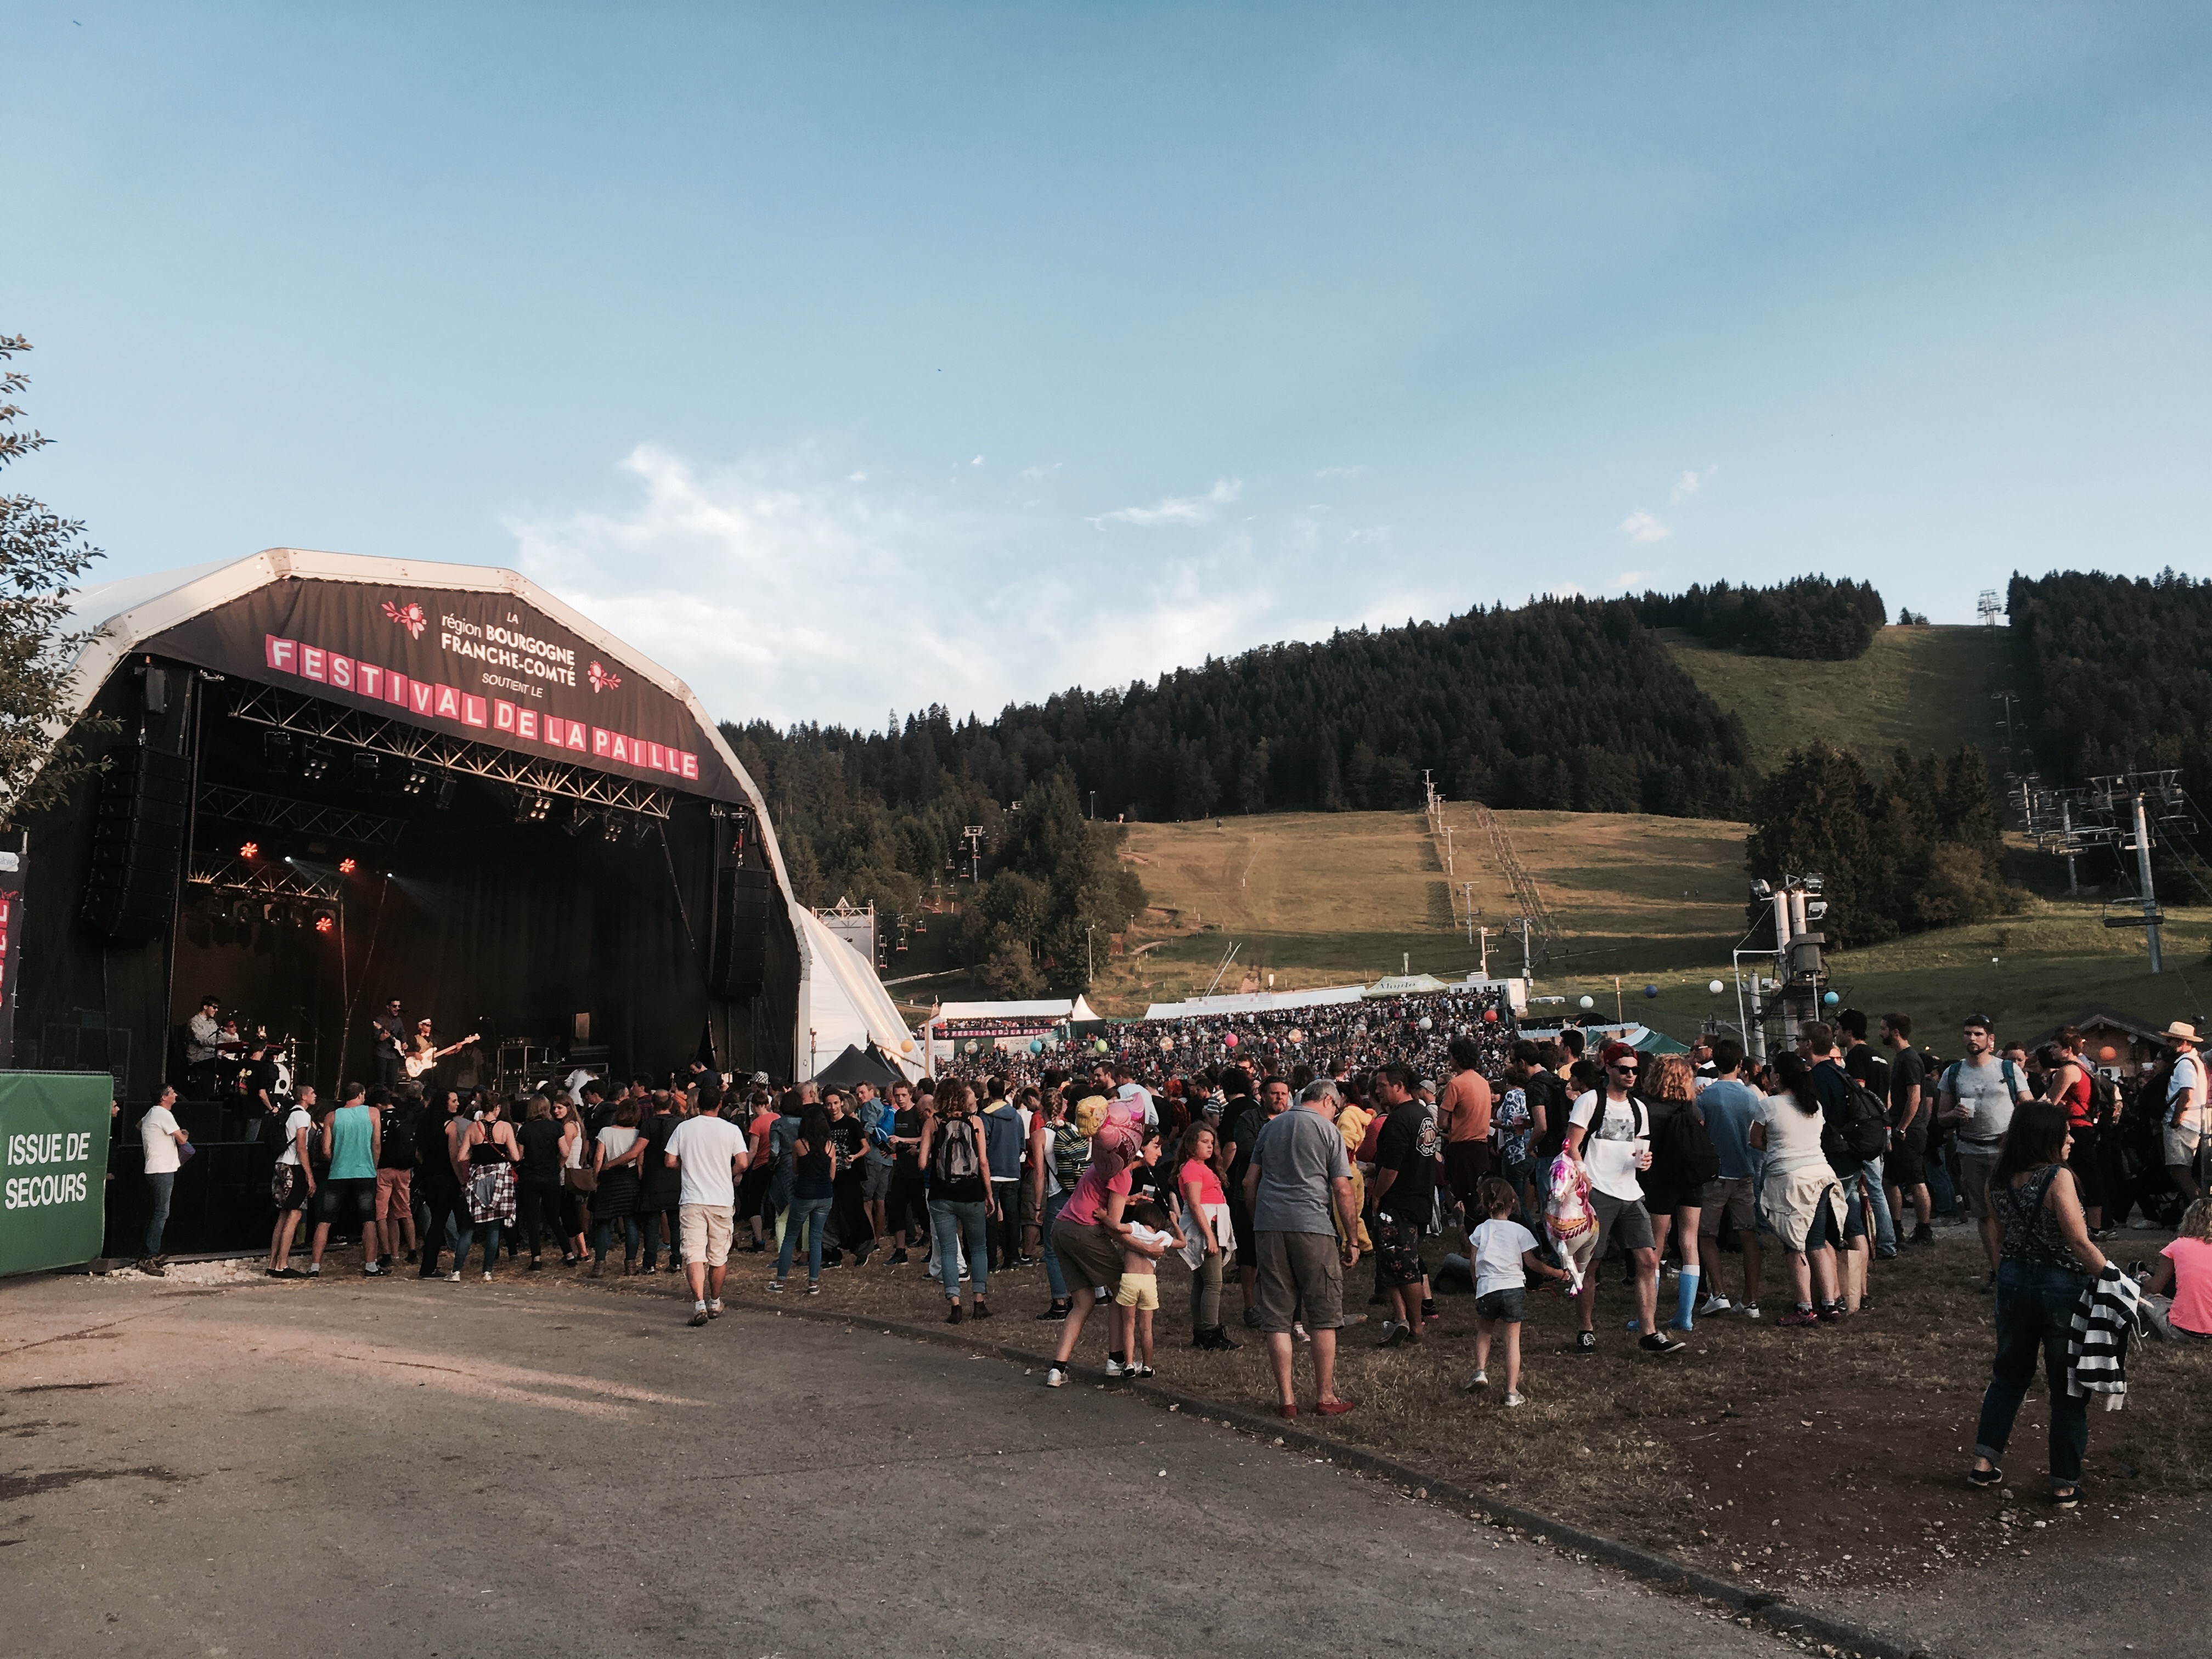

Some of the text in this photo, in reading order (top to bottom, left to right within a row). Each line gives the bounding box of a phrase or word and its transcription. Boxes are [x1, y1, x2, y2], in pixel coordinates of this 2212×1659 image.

[506, 612, 519, 624] LA
[441, 613, 575, 666] région BOURGOGNE
[441, 633, 576, 686] FRANCHE-COMTÉ
[482, 673, 544, 698] SOUTIENT LE
[273, 640, 696, 777] FESTIVAL DE LA PAILLE
[8, 1132, 91, 1166] ISSUE DE
[5, 1172, 87, 1210] SECOURS
